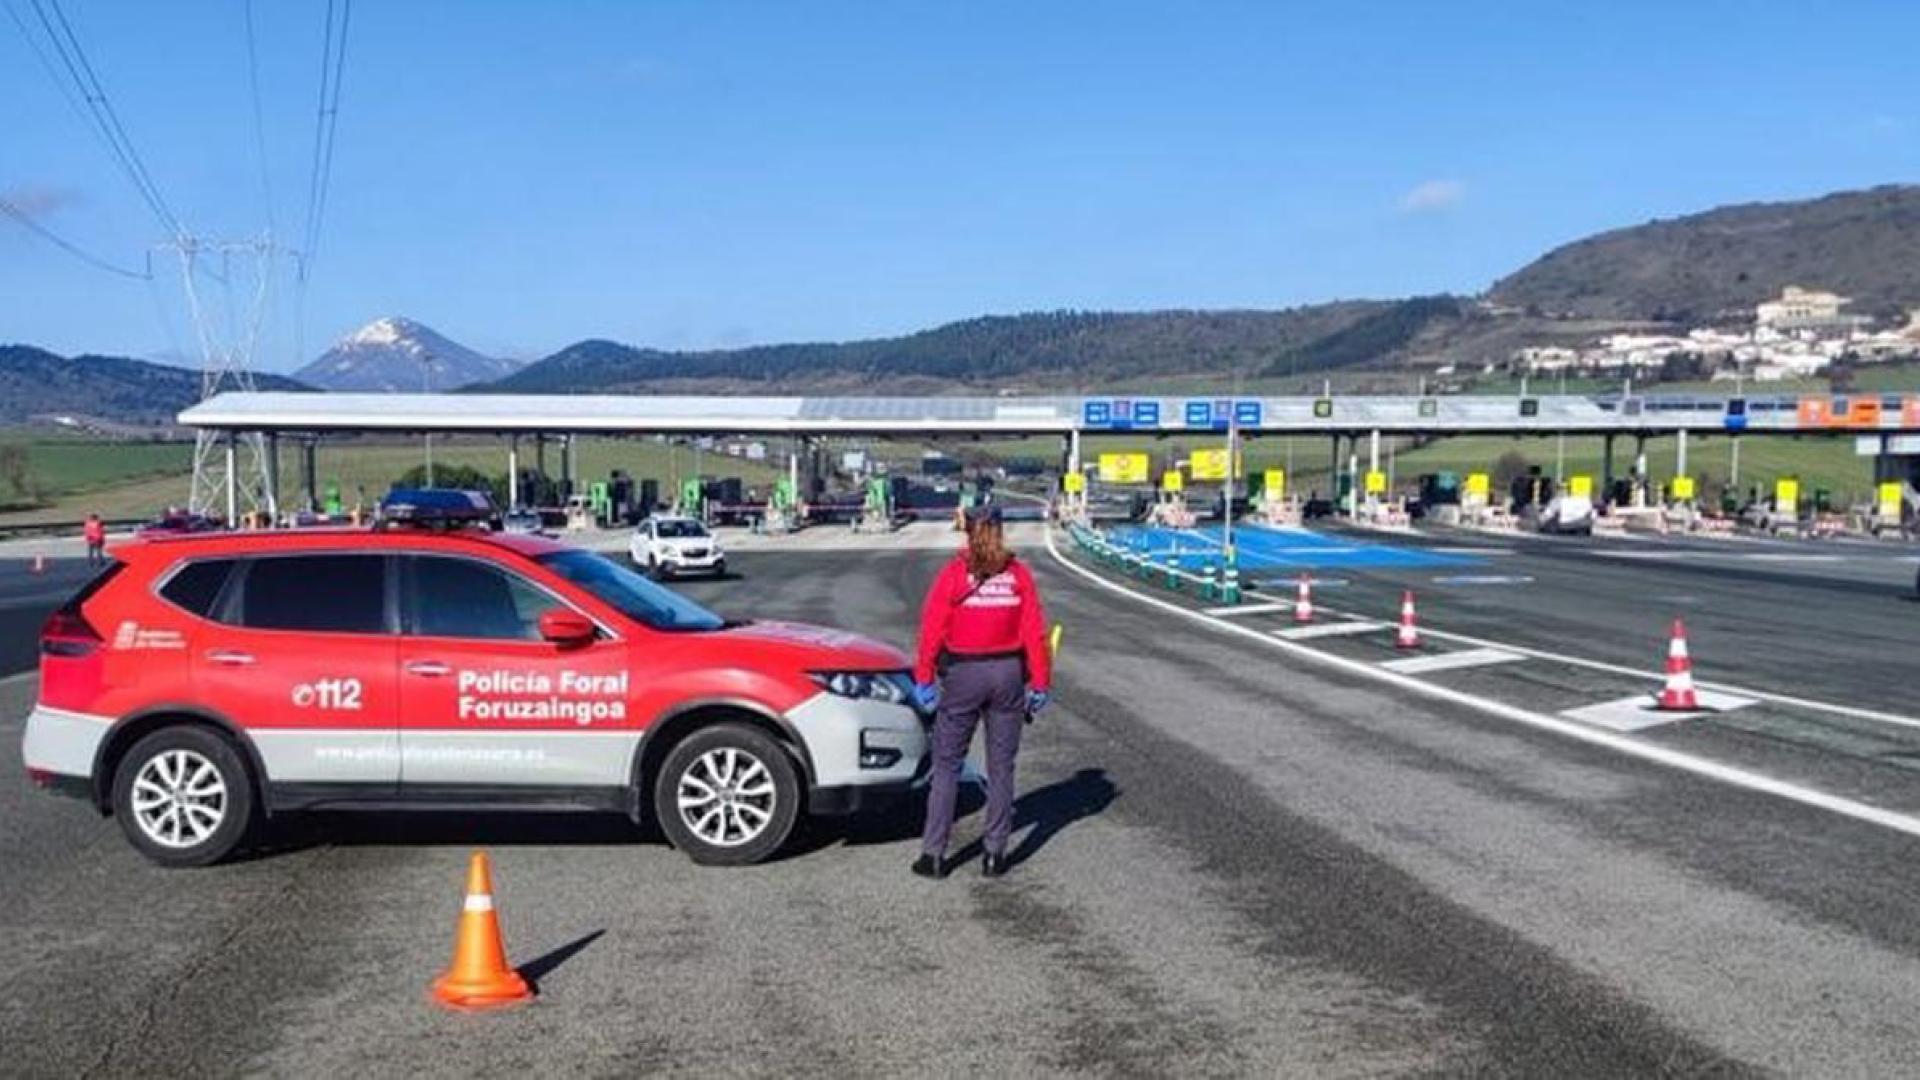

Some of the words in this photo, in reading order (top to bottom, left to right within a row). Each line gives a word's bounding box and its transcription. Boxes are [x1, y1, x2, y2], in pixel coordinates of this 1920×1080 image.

[316, 678, 363, 710] 112
[458, 669, 550, 693] Policía
[559, 669, 630, 693] Foral
[458, 695, 627, 724] Foruzaingoa
